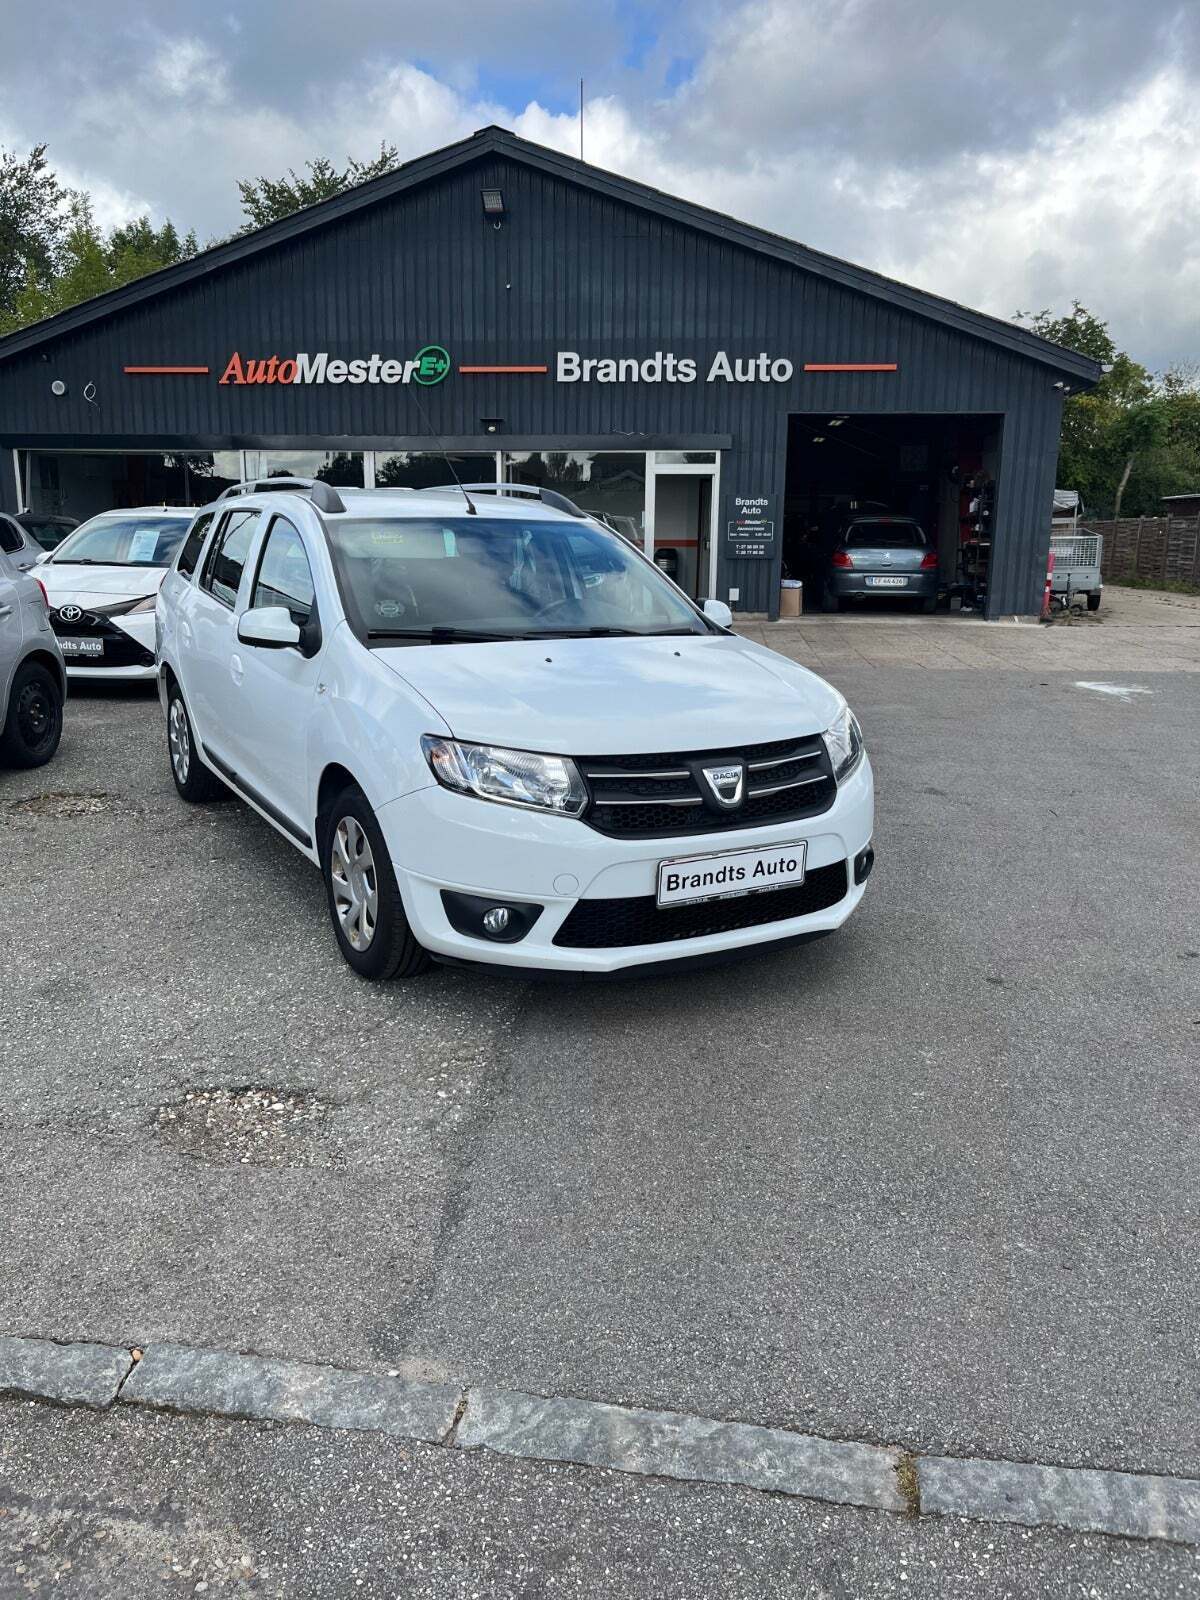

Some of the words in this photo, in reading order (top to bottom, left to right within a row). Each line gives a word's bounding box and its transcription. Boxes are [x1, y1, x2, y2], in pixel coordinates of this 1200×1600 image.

[556, 351, 698, 383] Brandts
[706, 351, 794, 383] Auto
[736, 498, 768, 506] Brandts
[79, 641, 102, 651] Auto
[713, 772, 739, 780] DACIA
[666, 865, 746, 892] Brandts
[752, 858, 797, 878] Auto
